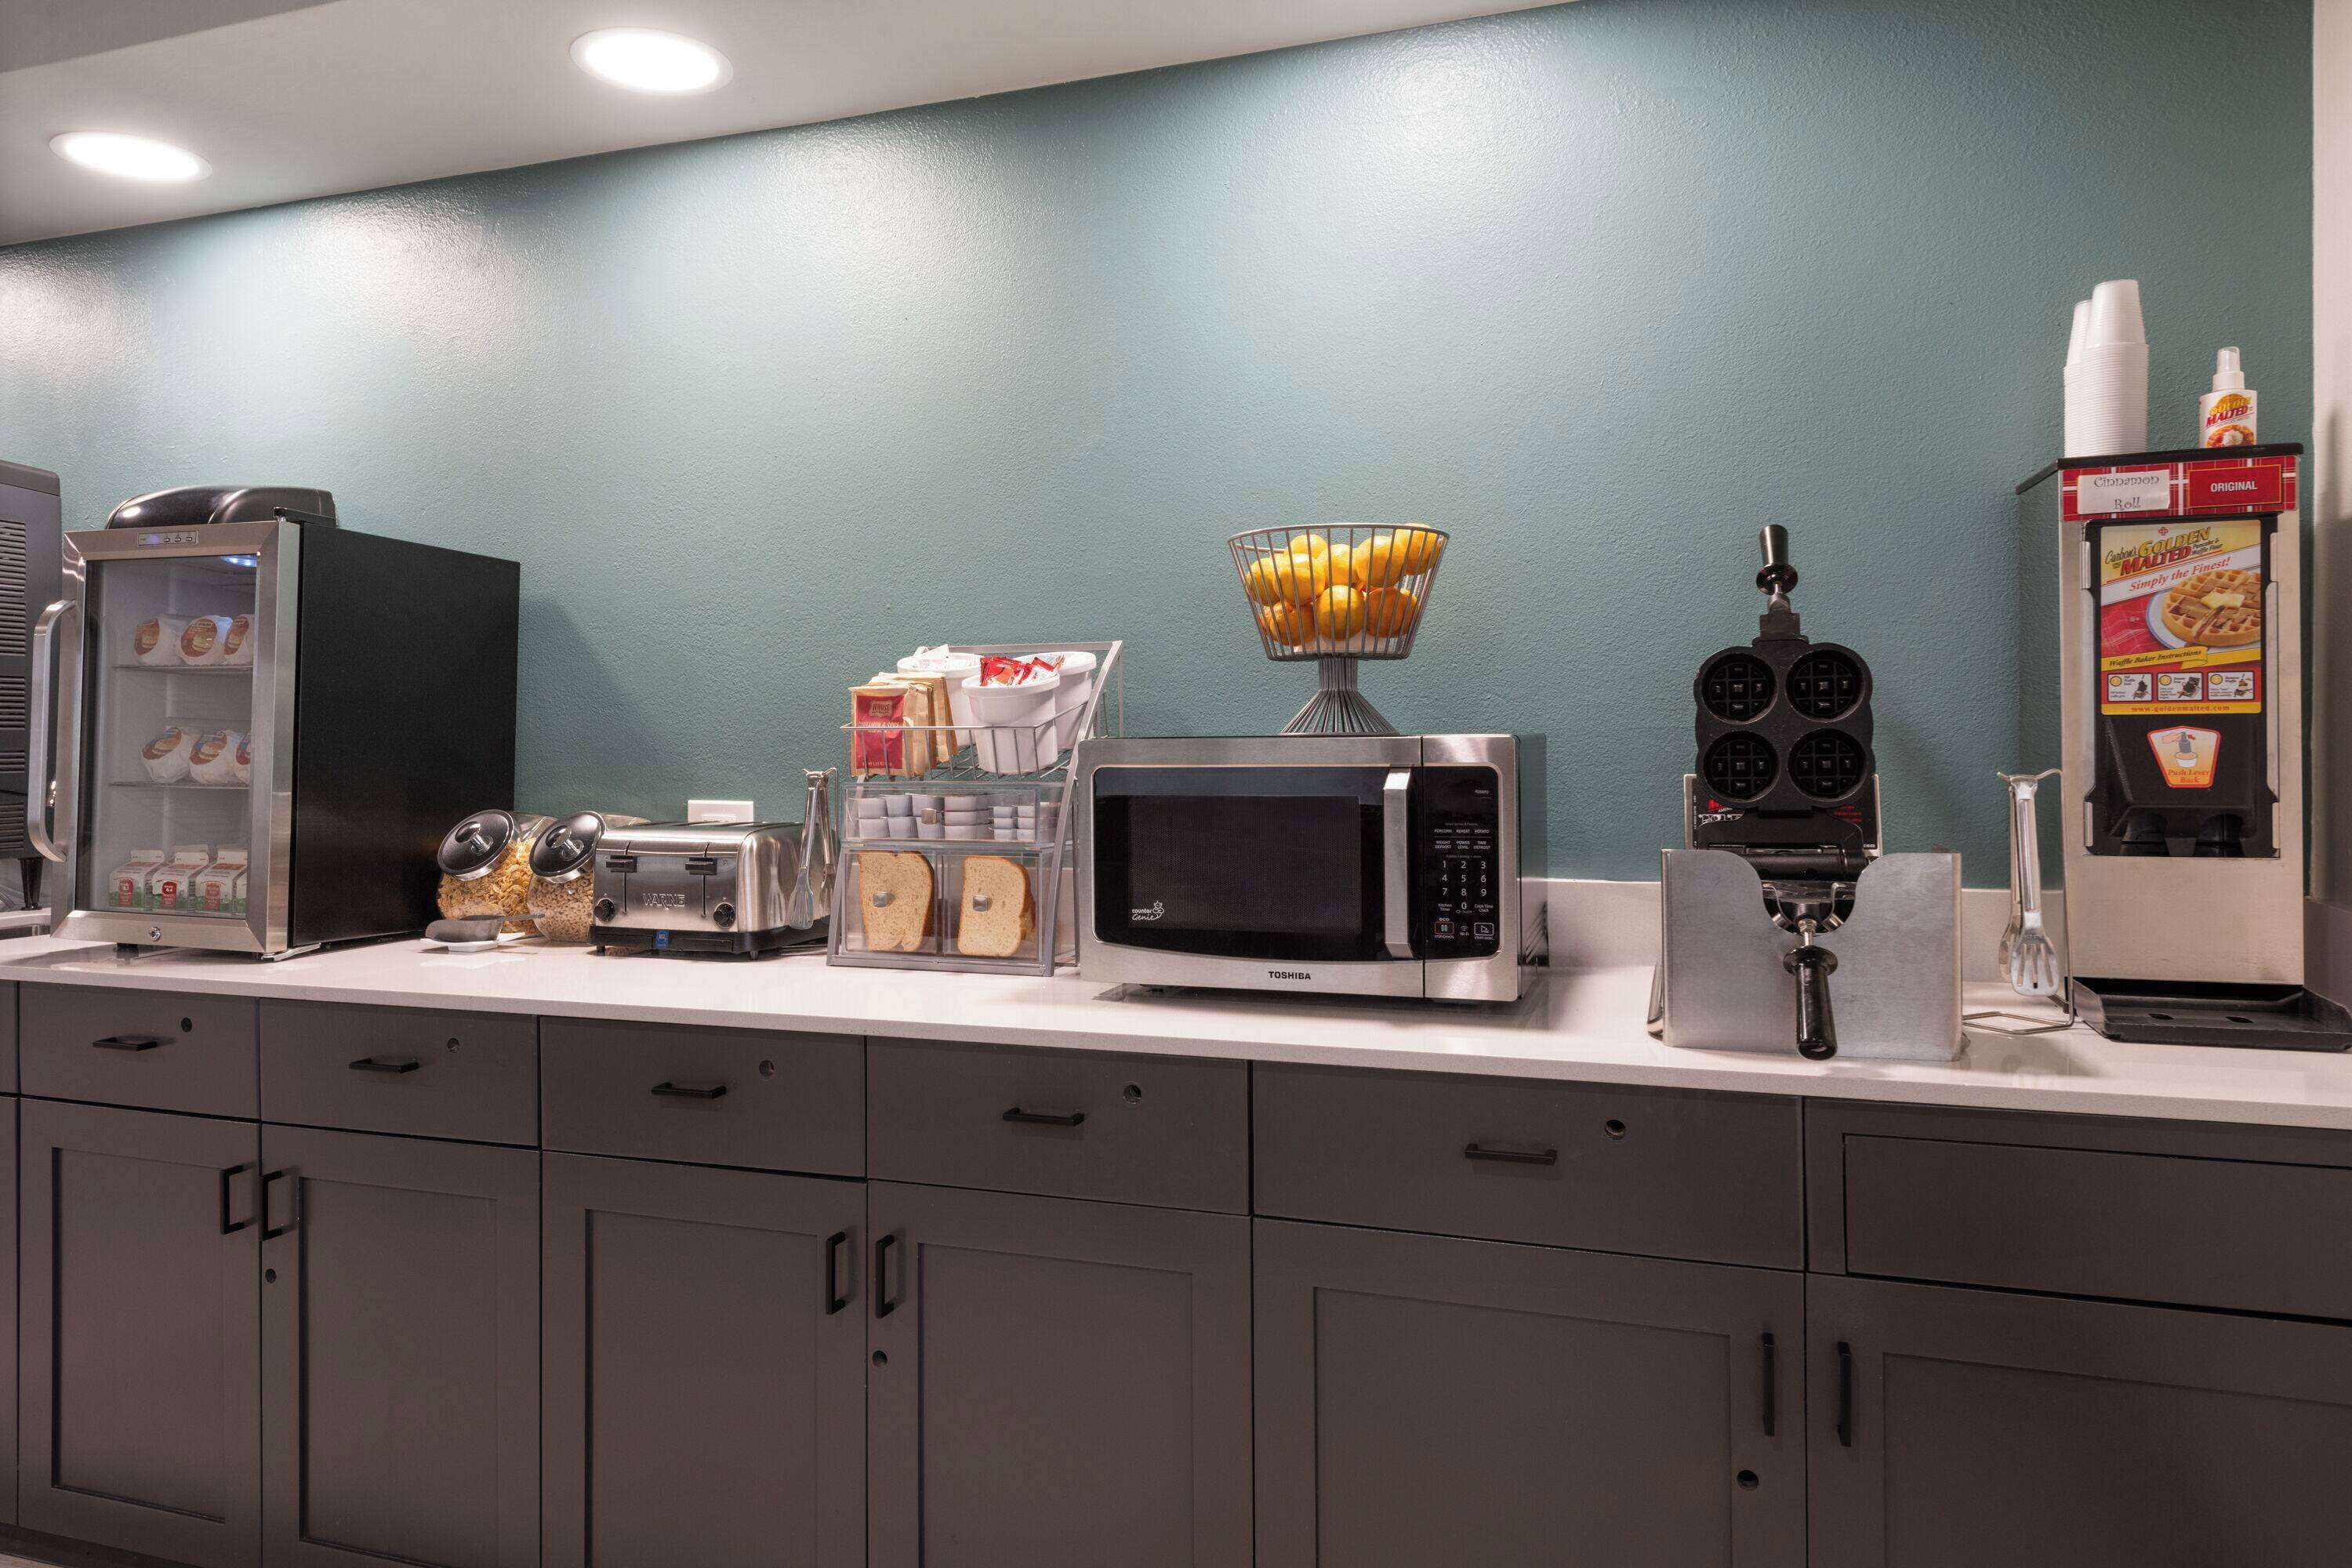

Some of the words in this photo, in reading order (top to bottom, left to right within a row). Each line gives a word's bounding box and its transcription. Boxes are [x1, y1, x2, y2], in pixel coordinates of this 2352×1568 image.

[2207, 405, 2249, 426] MALTED
[2094, 476, 2160, 488] Cinnamon
[2210, 481, 2258, 492] ORIGINAL
[2114, 496, 2142, 510] Roll
[2138, 527, 2211, 558] GOLDEN
[2120, 546, 2193, 575] MALTED
[2129, 574, 2169, 591] Simply
[2171, 568, 2189, 579] the
[2192, 556, 2232, 575] Finest!
[2108, 658, 2135, 667] Waffle
[2135, 655, 2156, 664] Baker
[2157, 649, 2202, 661] Instructions
[643, 893, 685, 909] WARING
[1268, 971, 1311, 980] TOSHIBA
